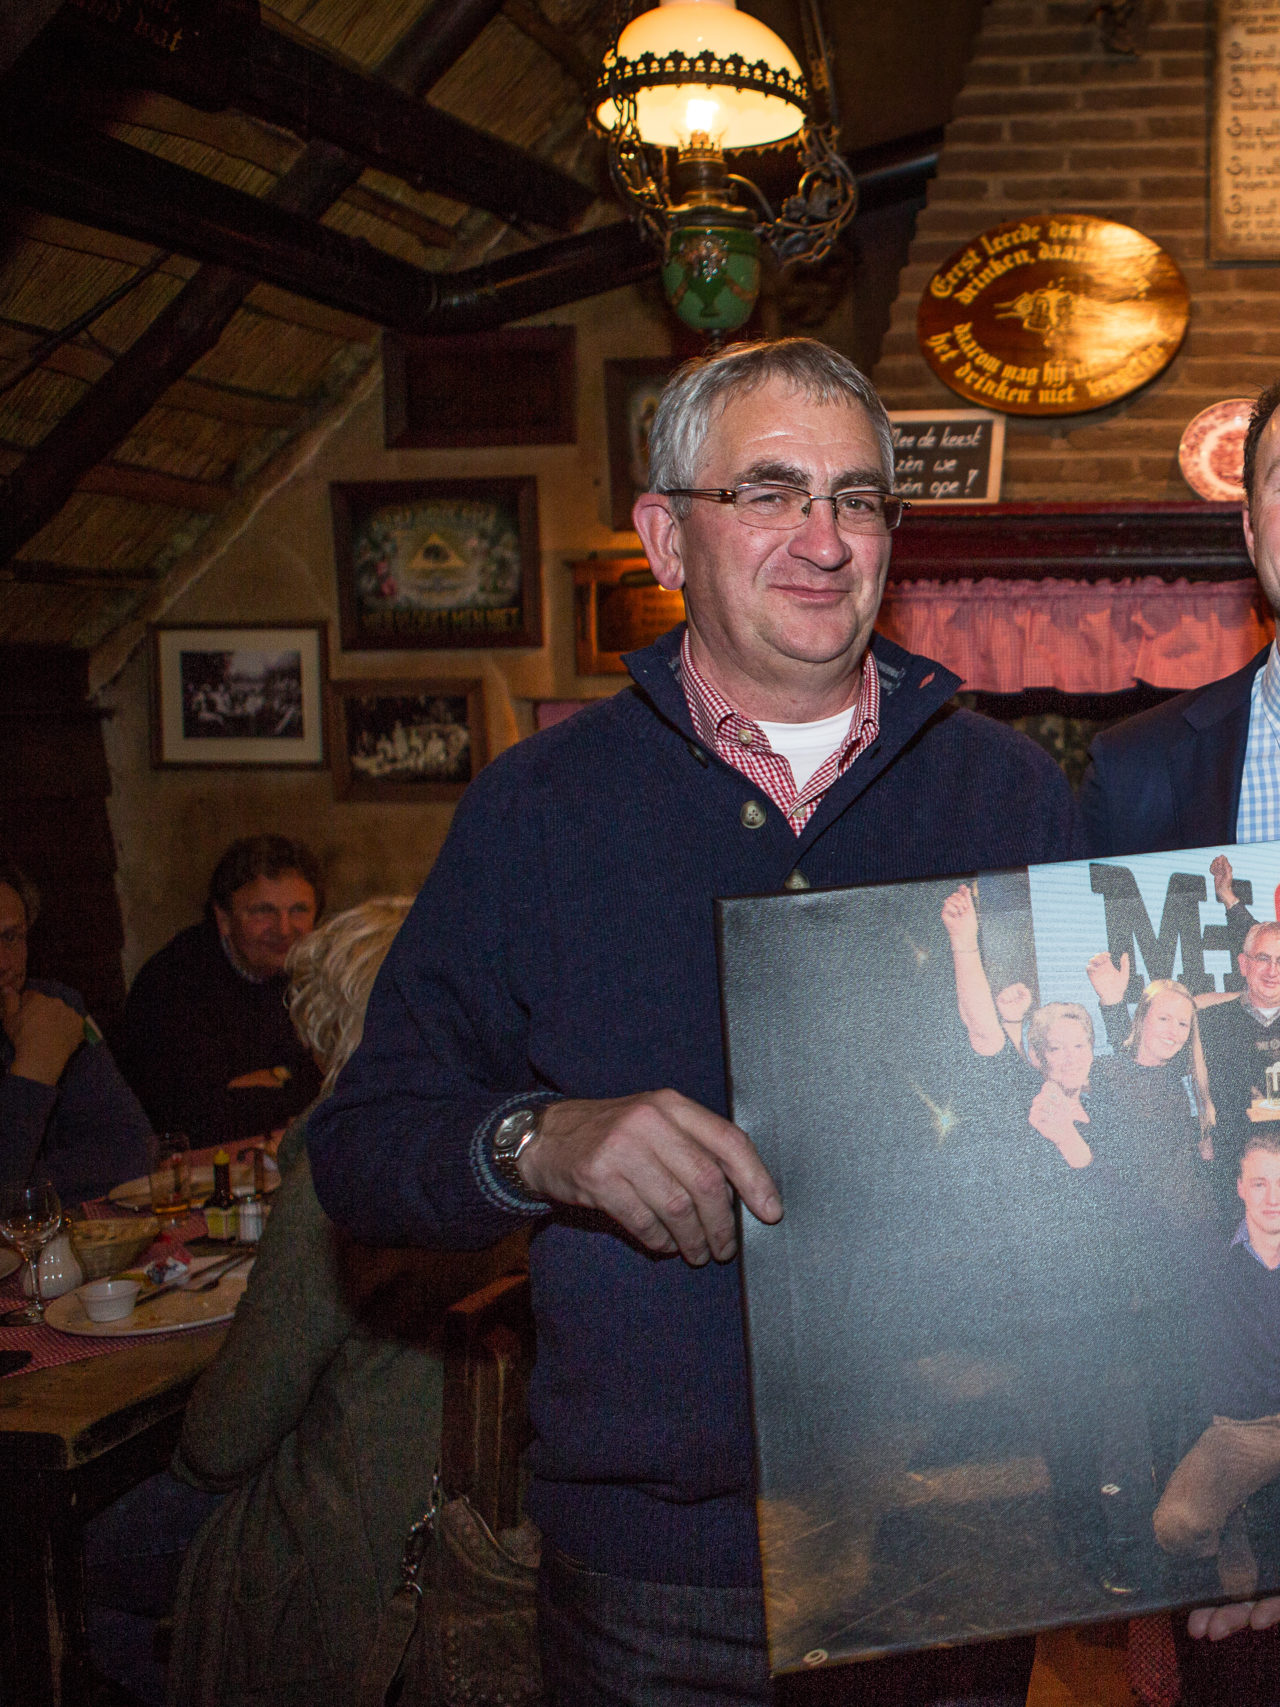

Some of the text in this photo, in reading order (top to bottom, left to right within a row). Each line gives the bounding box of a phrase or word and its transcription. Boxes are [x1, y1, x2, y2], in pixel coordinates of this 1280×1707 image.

[980, 223, 1042, 256] leerde
[1048, 219, 1085, 240] den
[925, 331, 962, 364] het
[954, 361, 1033, 405] drinken
[1037, 382, 1078, 405] niet
[952, 321, 1003, 374] daarom
[1001, 363, 1040, 387] mag
[1042, 358, 1068, 388] hij
